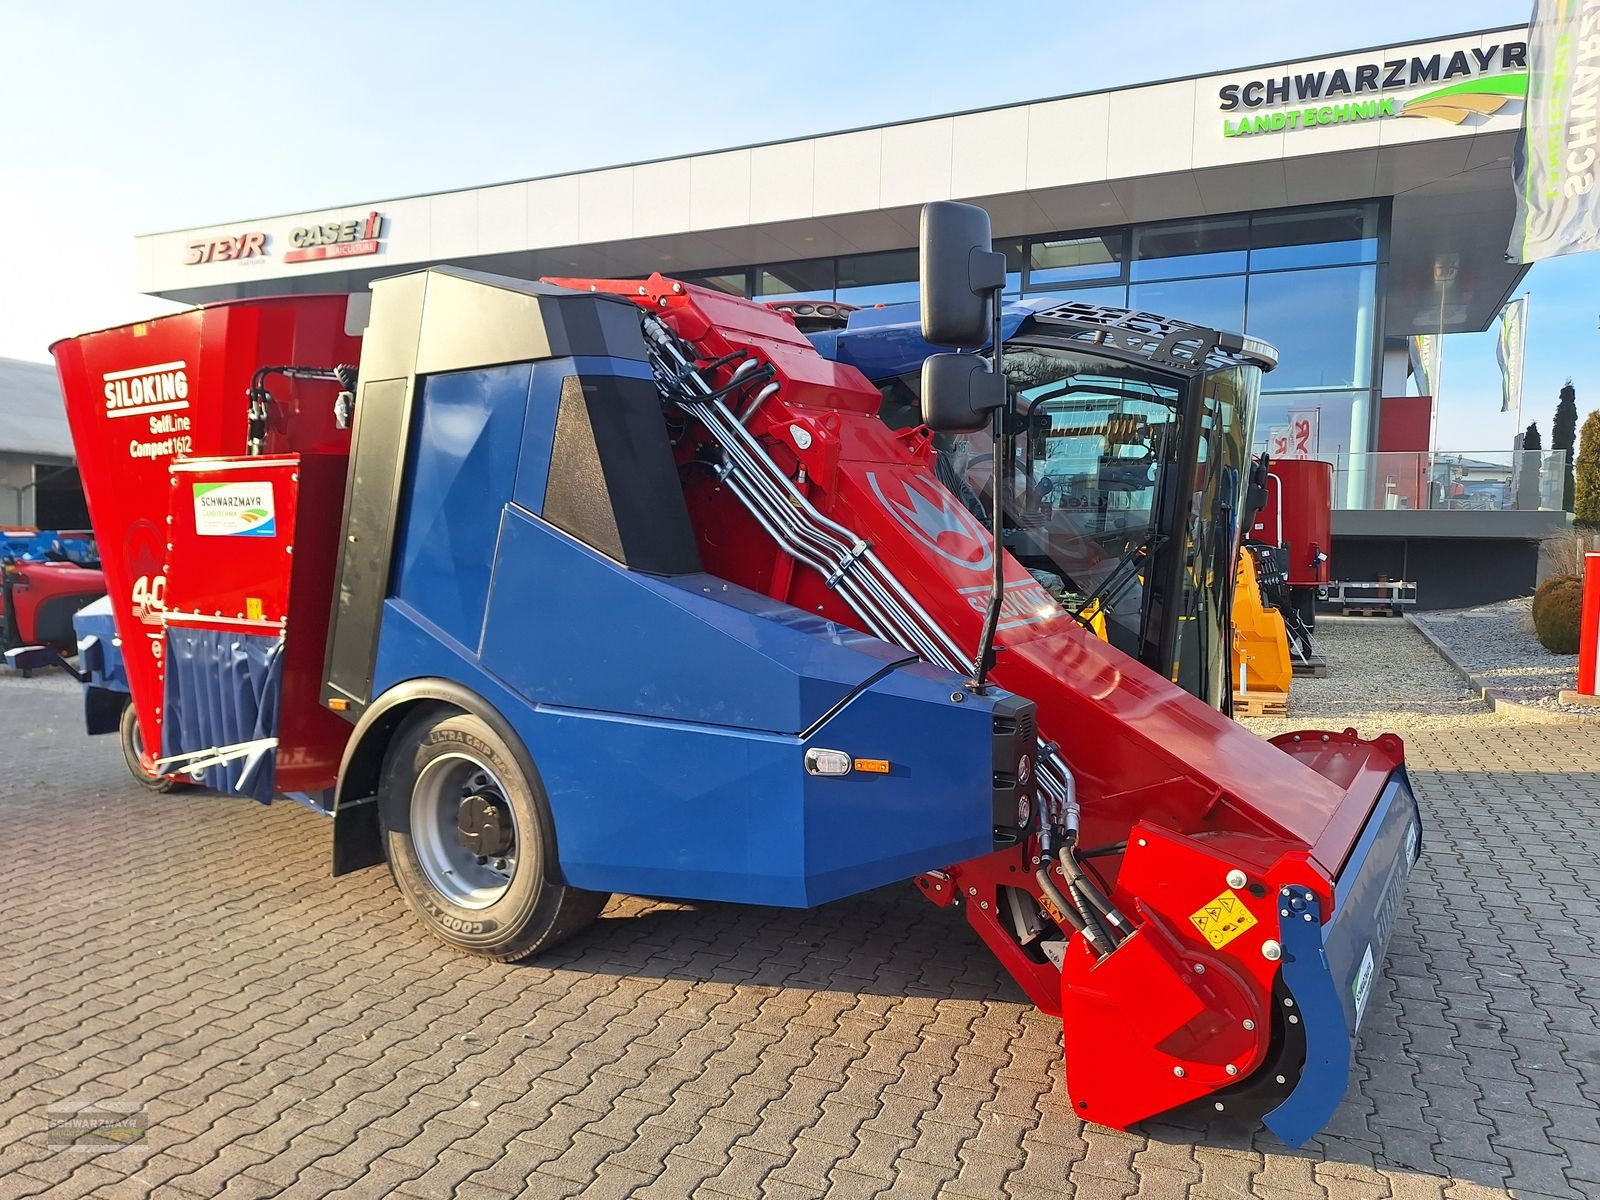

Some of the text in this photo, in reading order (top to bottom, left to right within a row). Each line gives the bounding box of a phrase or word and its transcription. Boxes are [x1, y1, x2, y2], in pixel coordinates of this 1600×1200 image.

[1219, 41, 1528, 112] SCHWARZMAYR
[1223, 97, 1396, 137] LANDTECHNIK
[184, 232, 267, 265] STEYR
[289, 220, 358, 248] CASE
[104, 371, 188, 409] SILOKING
[149, 413, 191, 434] SelfLine
[201, 496, 262, 507] SCHWARZMAYR
[430, 730, 464, 743] ULTRA
[465, 734, 492, 756] GRIP
